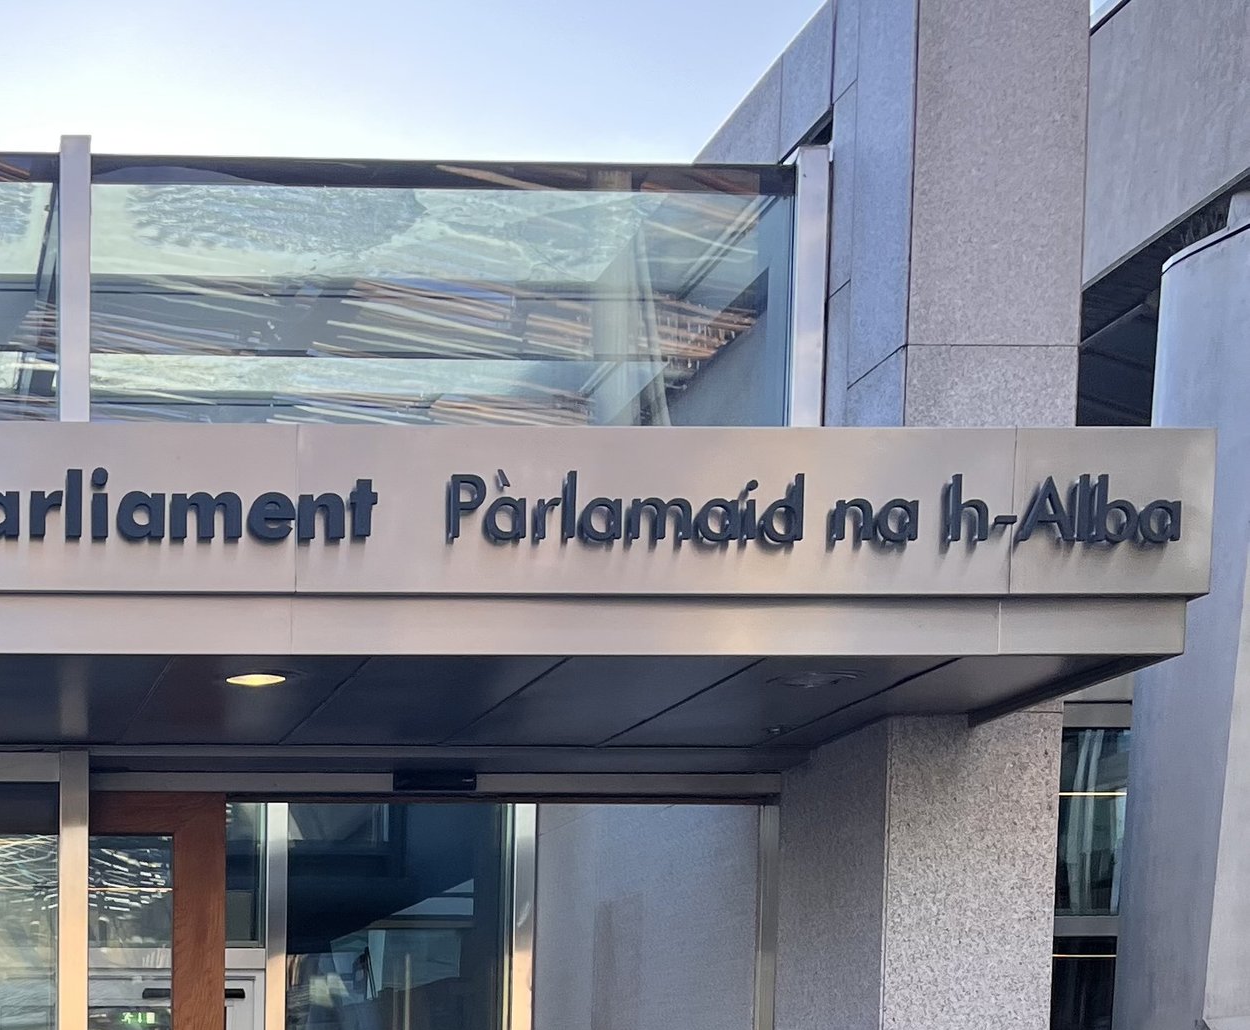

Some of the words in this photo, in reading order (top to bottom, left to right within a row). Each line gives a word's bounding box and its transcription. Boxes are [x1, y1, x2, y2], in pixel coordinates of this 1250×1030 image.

[447, 469, 805, 544] Pàrlamaid
[830, 498, 919, 543] na
[944, 473, 1182, 544] h-Alba
